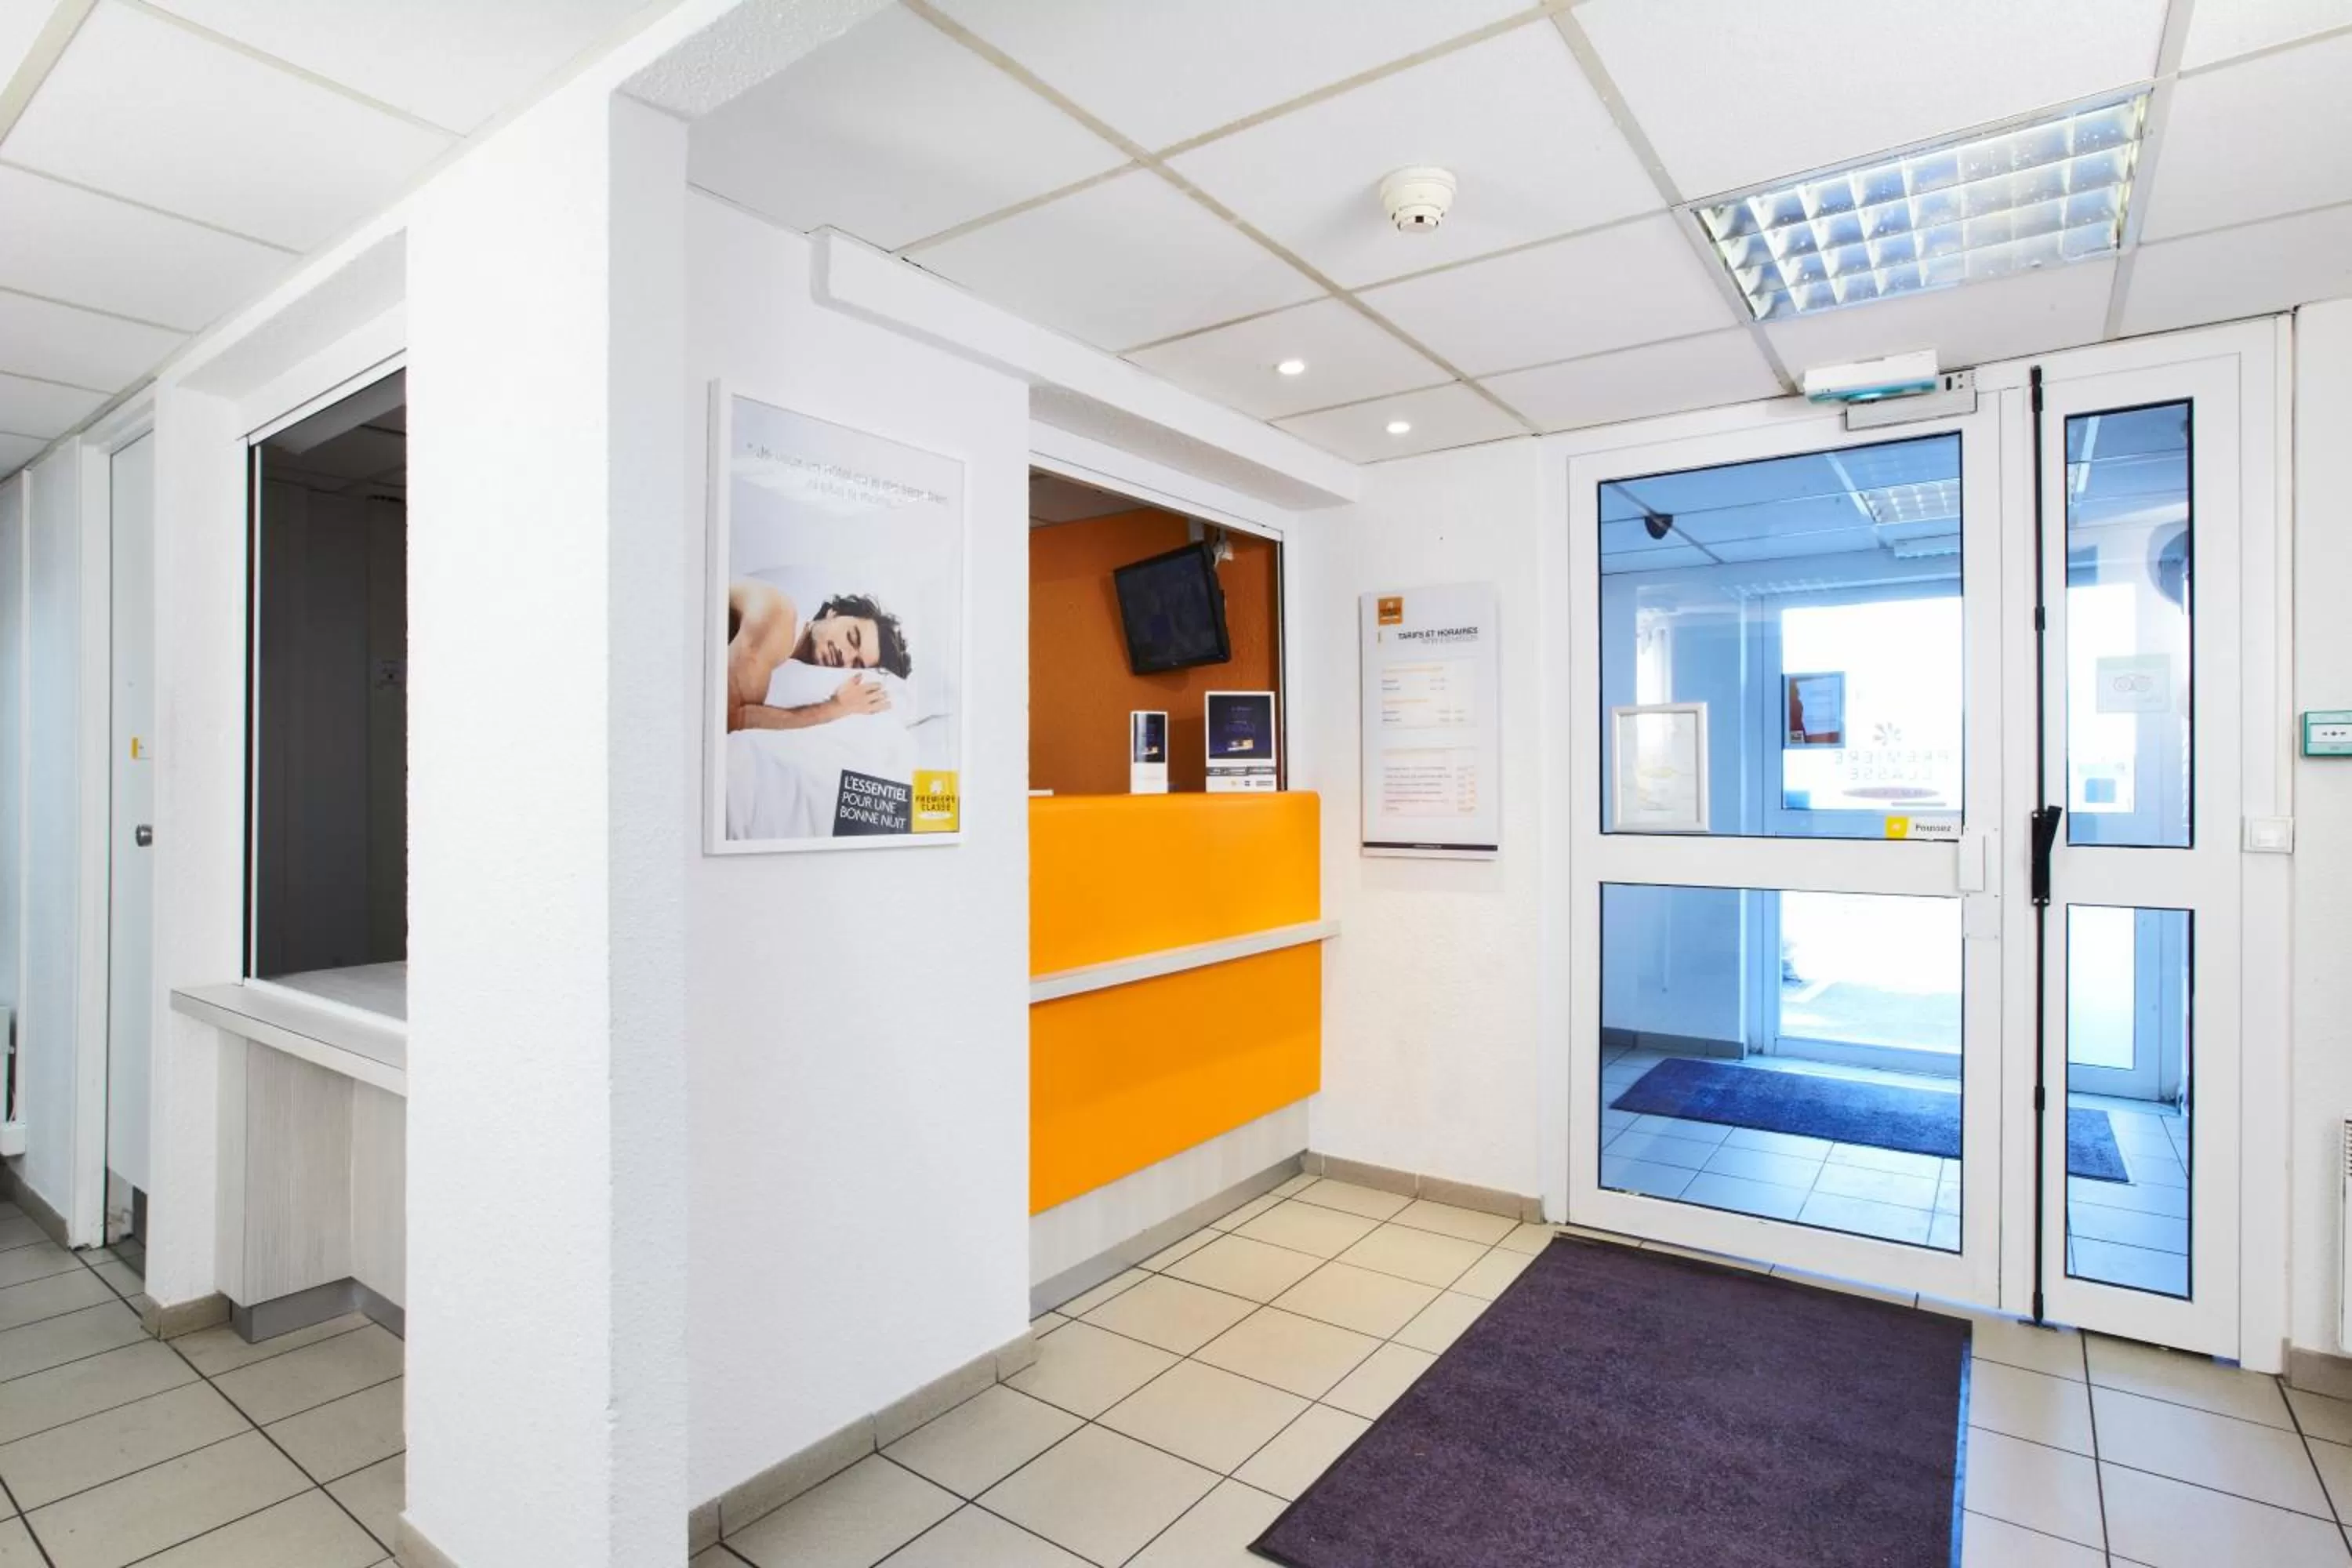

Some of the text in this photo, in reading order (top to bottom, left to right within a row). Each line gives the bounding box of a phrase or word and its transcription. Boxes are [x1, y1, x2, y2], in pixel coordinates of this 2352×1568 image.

[1398, 630, 1424, 640] TARIFS
[1437, 626, 1478, 636] HORAIRES
[844, 775, 908, 802] L'ESSENTIEL
[841, 792, 897, 814] POUR UNE
[921, 803, 951, 811] CLASSE
[840, 806, 907, 829] BONNE NUIT
